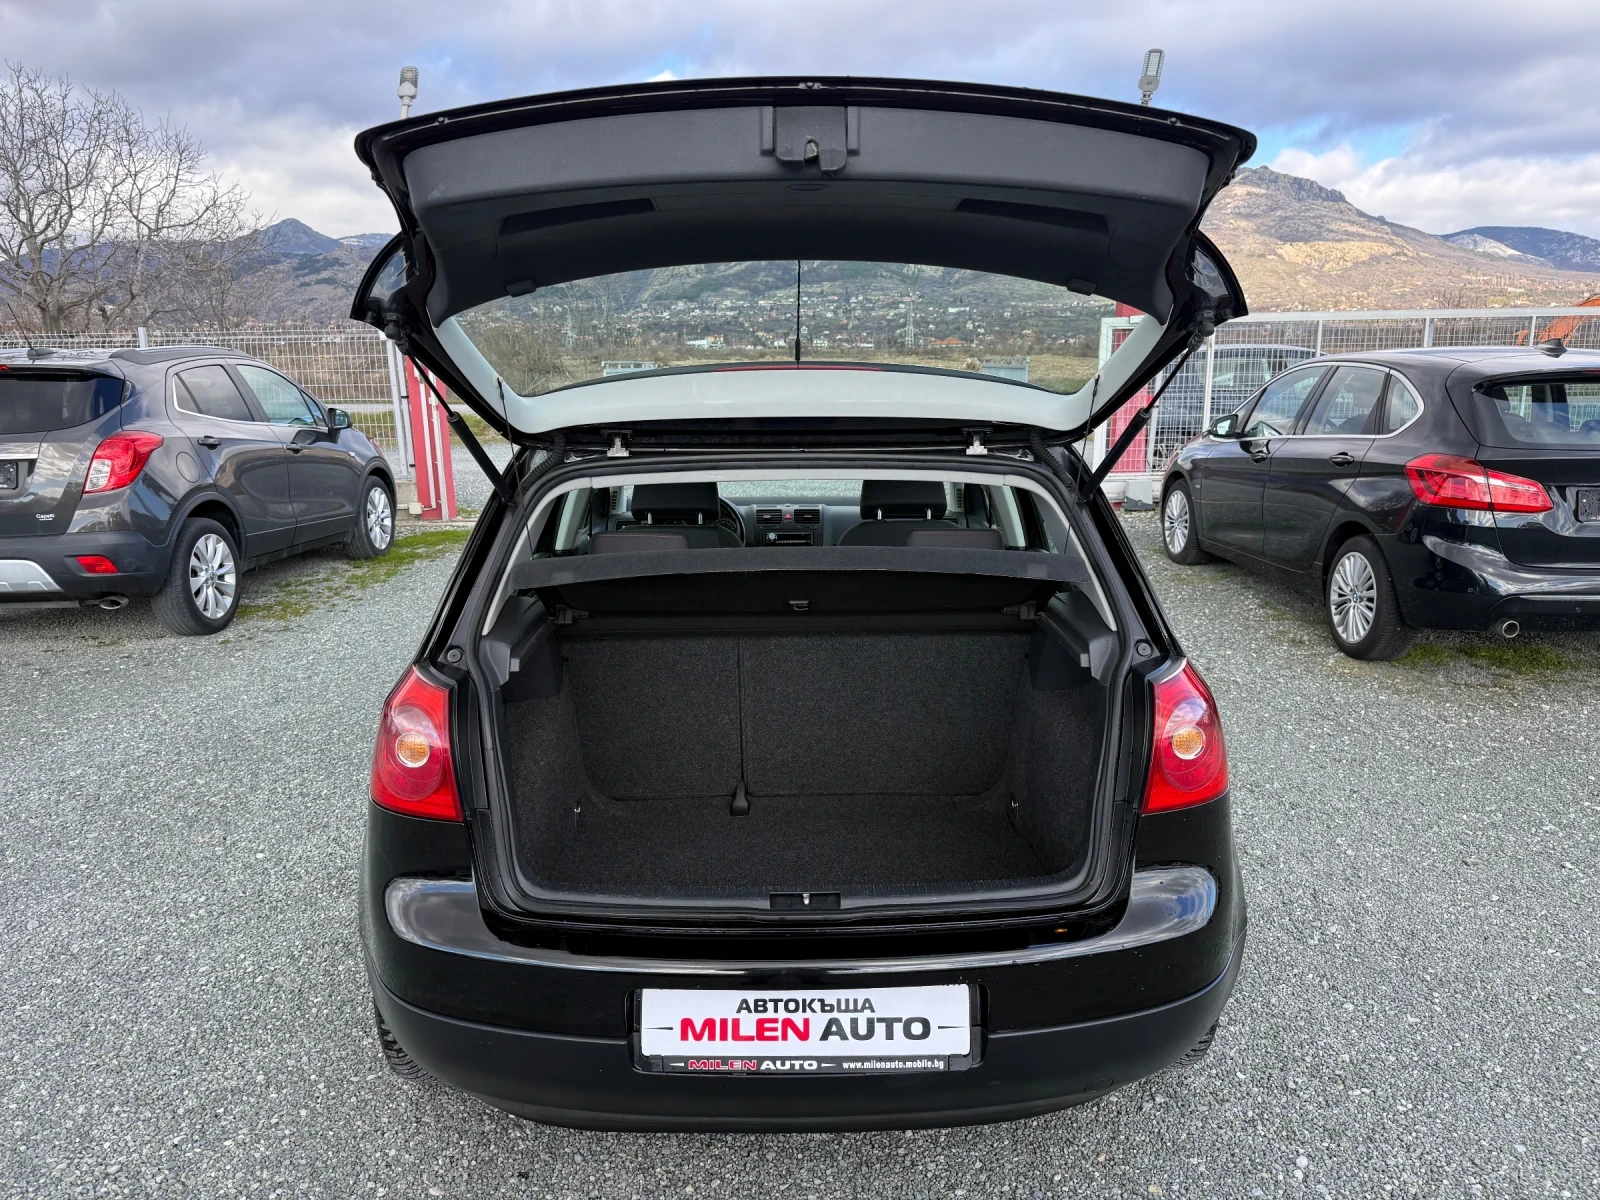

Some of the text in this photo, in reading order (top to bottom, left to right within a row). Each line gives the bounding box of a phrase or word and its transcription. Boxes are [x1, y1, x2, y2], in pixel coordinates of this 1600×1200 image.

[680, 1016, 931, 1042] MILEN AUTO
[688, 1059, 818, 1070] MILEN AUTO
[842, 1059, 944, 1071] www.milenauto.mobile.bg
